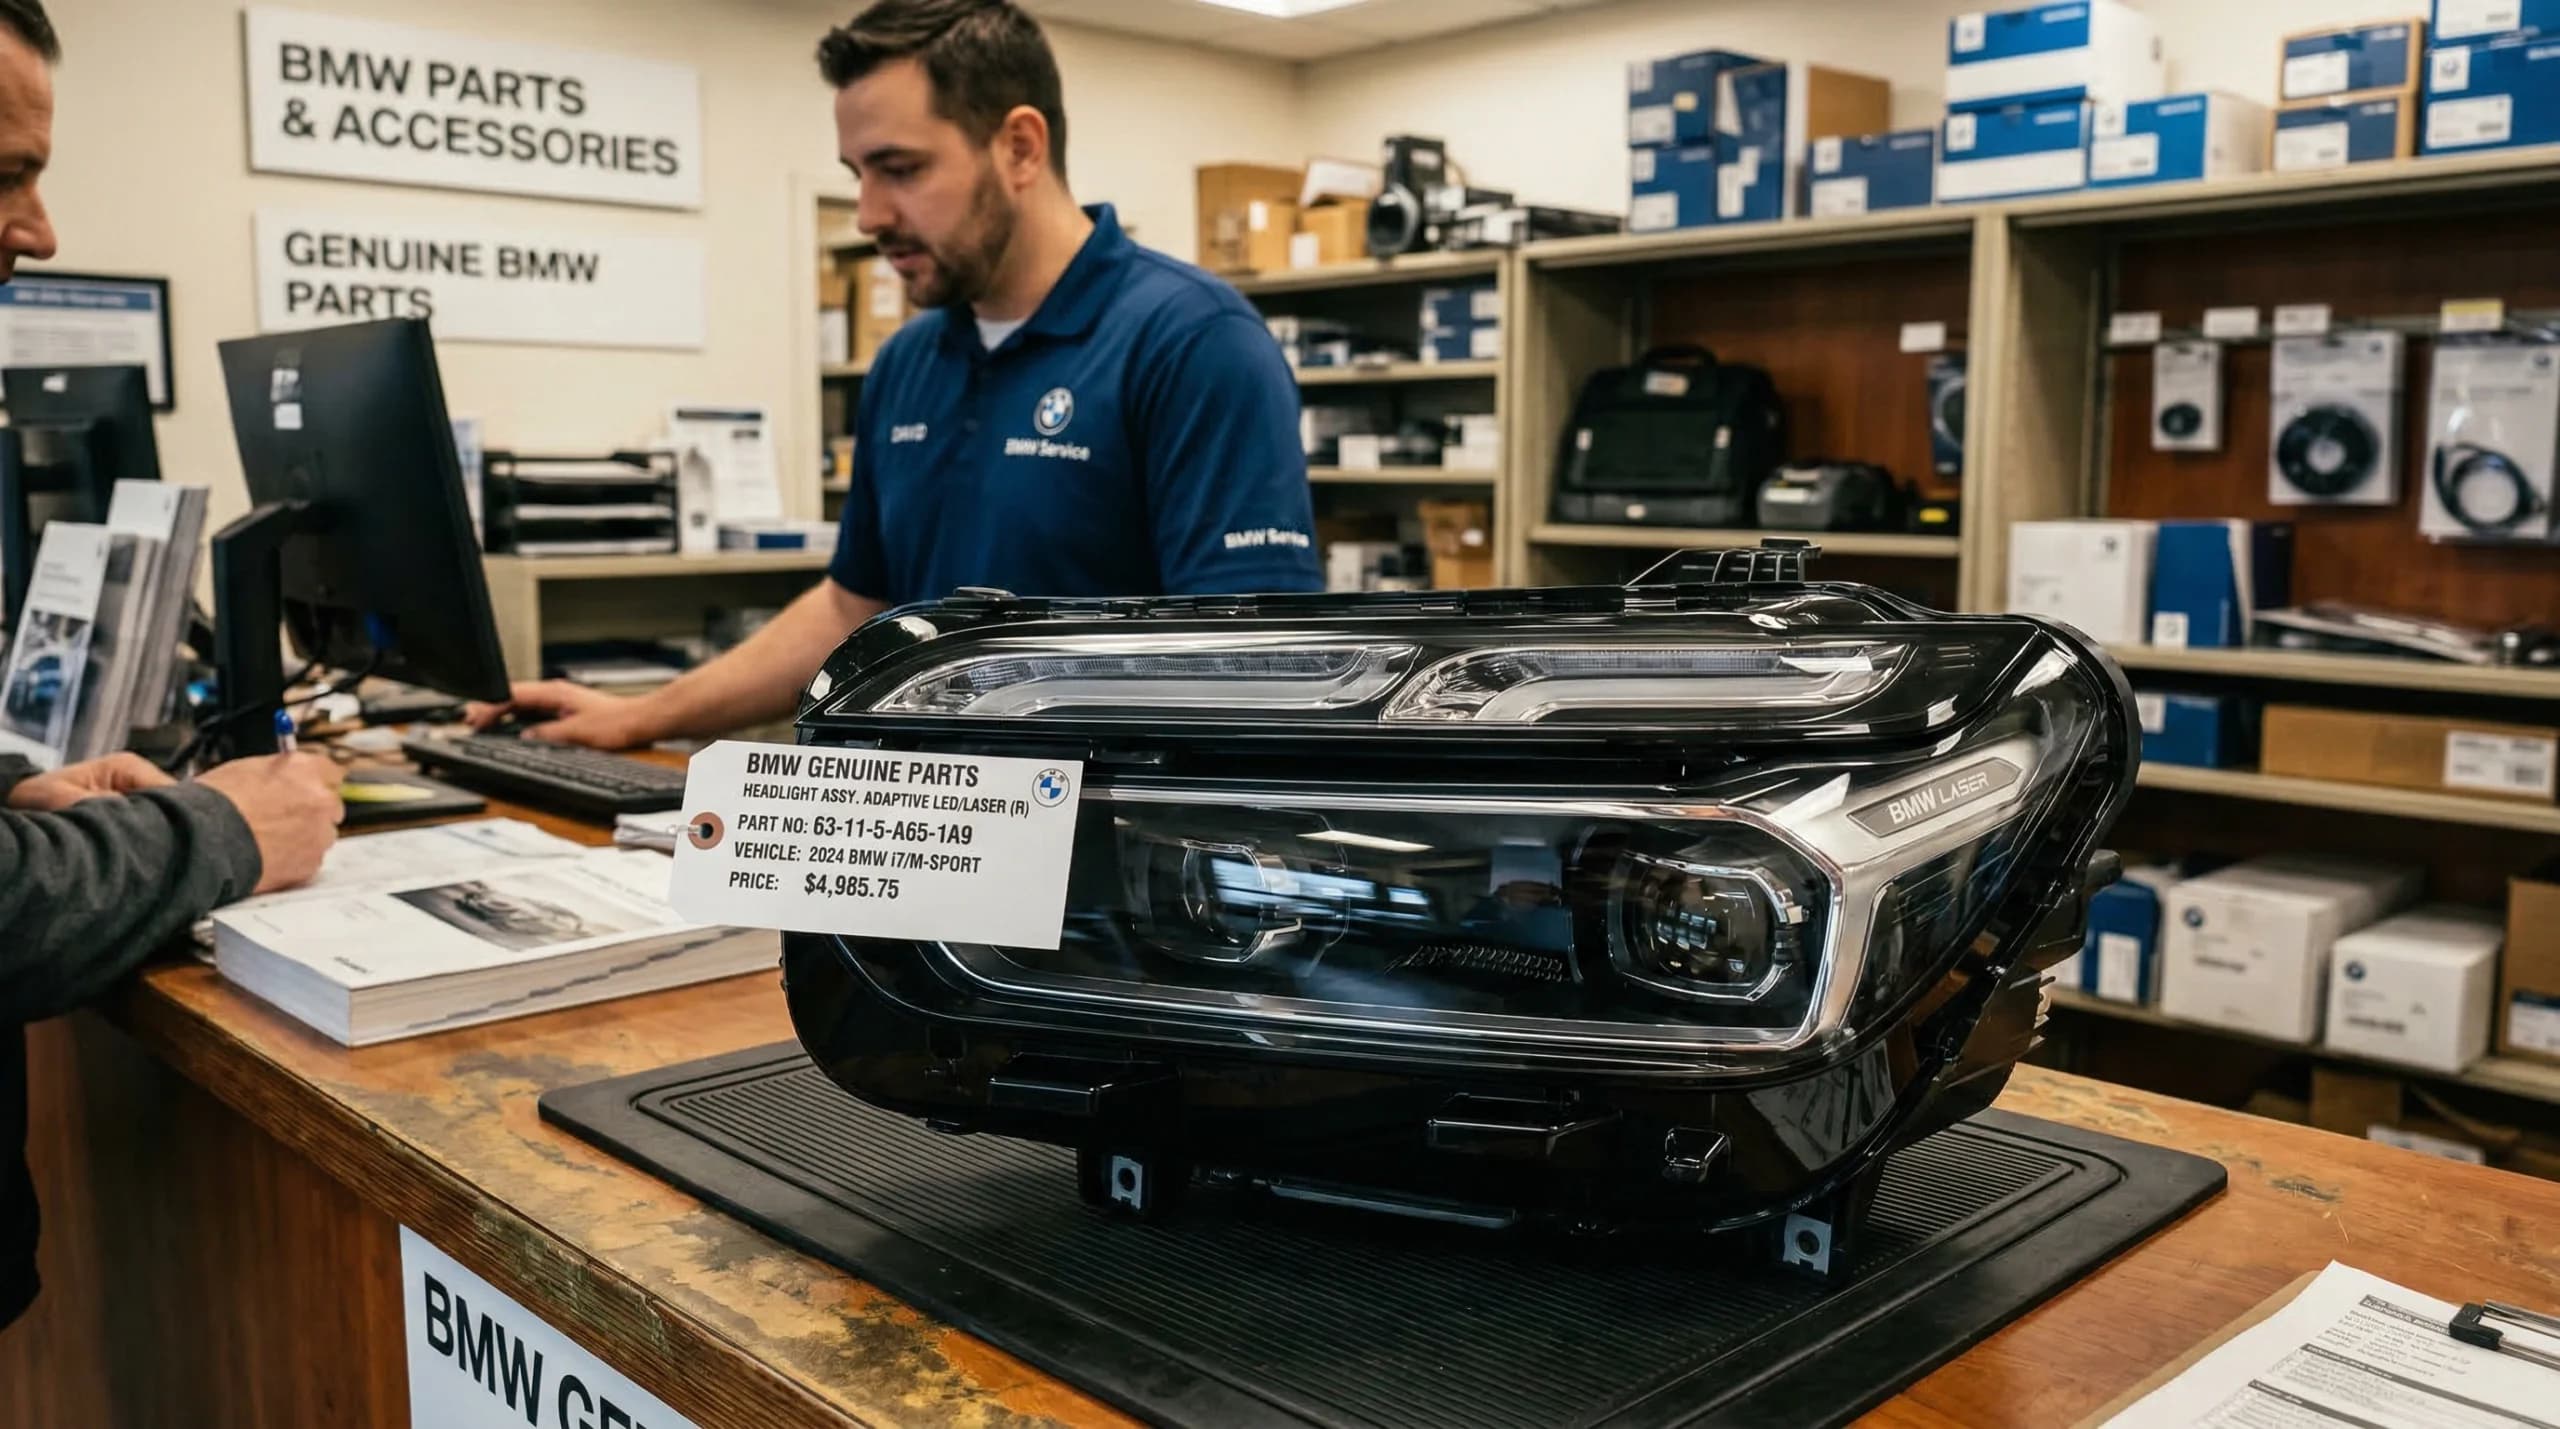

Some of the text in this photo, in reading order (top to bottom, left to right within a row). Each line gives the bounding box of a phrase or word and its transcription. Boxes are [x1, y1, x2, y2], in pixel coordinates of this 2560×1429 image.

[280, 43, 586, 116] BMW PARTS
[282, 99, 679, 176] & ACCESSORIES
[285, 231, 599, 282] GENUINE BMW
[286, 280, 434, 319] PARTS
[746, 753, 979, 787] BMW GENUINE PARTS
[743, 783, 1030, 818] HEADLIGHT ASSY. ADAPTIVE LED/LASER (R)
[1888, 771, 1990, 825] BMW LASER
[737, 814, 973, 845] PART NO: 63-11-5-A65-1A9
[735, 841, 982, 873] VEHICLE: 2024 BMW i7/M-SPORT
[729, 871, 899, 899] PRICE: $4,985.75
[424, 1271, 543, 1427] BMW
